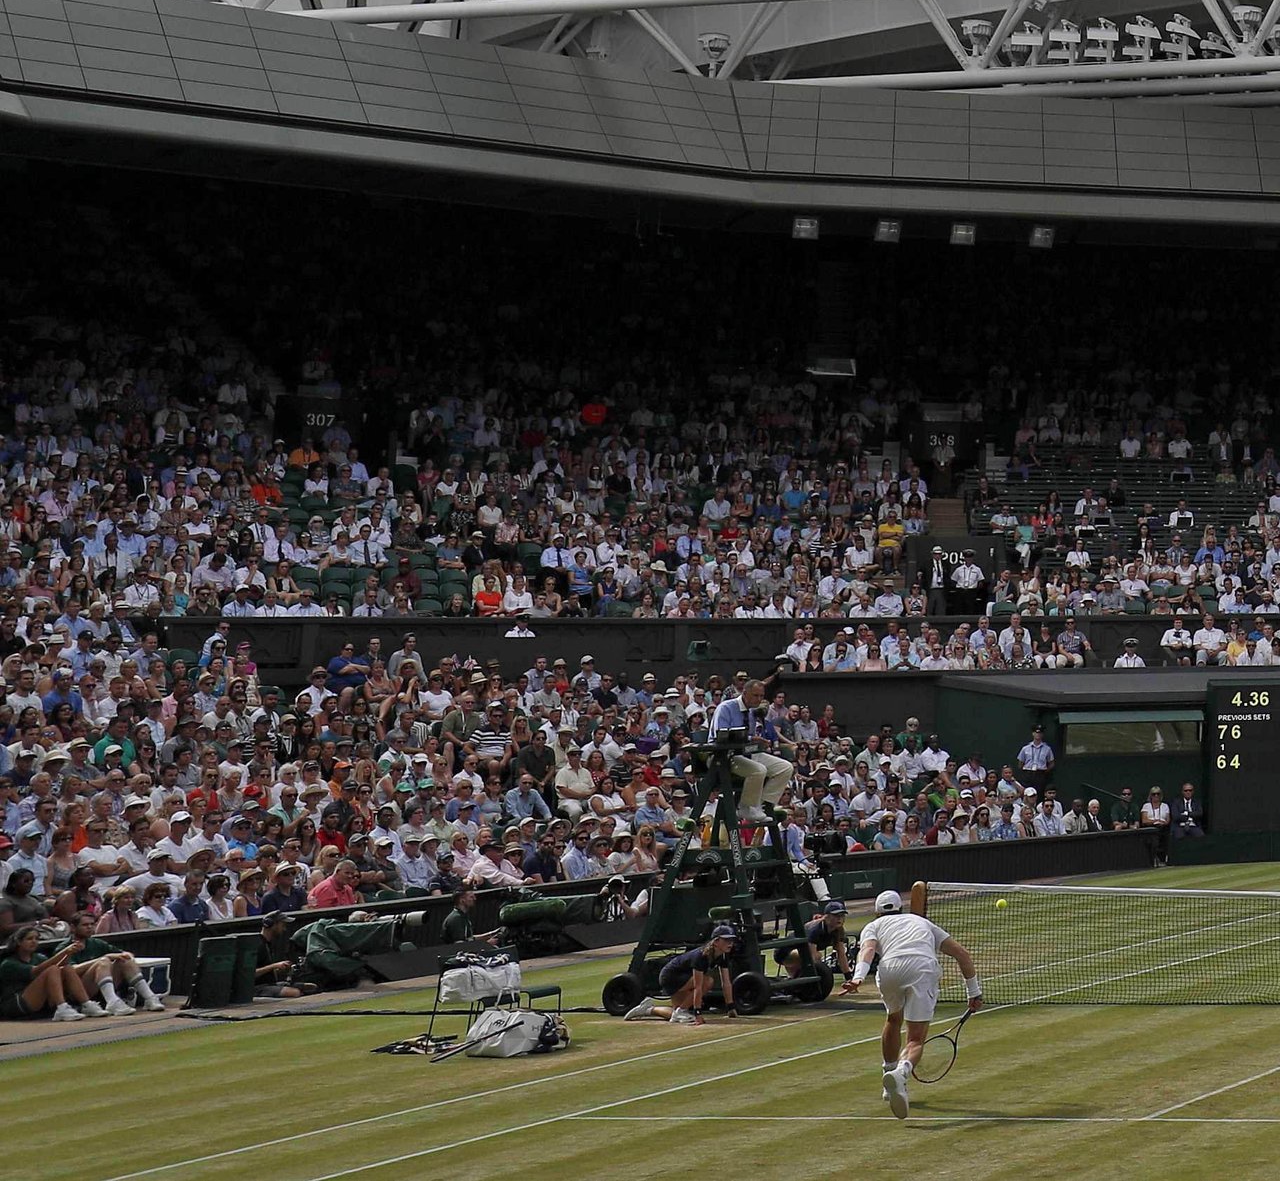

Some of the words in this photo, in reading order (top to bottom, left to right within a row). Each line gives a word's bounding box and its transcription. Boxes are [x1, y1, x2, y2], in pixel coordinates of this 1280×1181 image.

[305, 413, 336, 427] 307
[1231, 691, 1270, 707] 4.36
[1253, 713, 1271, 721] SETS
